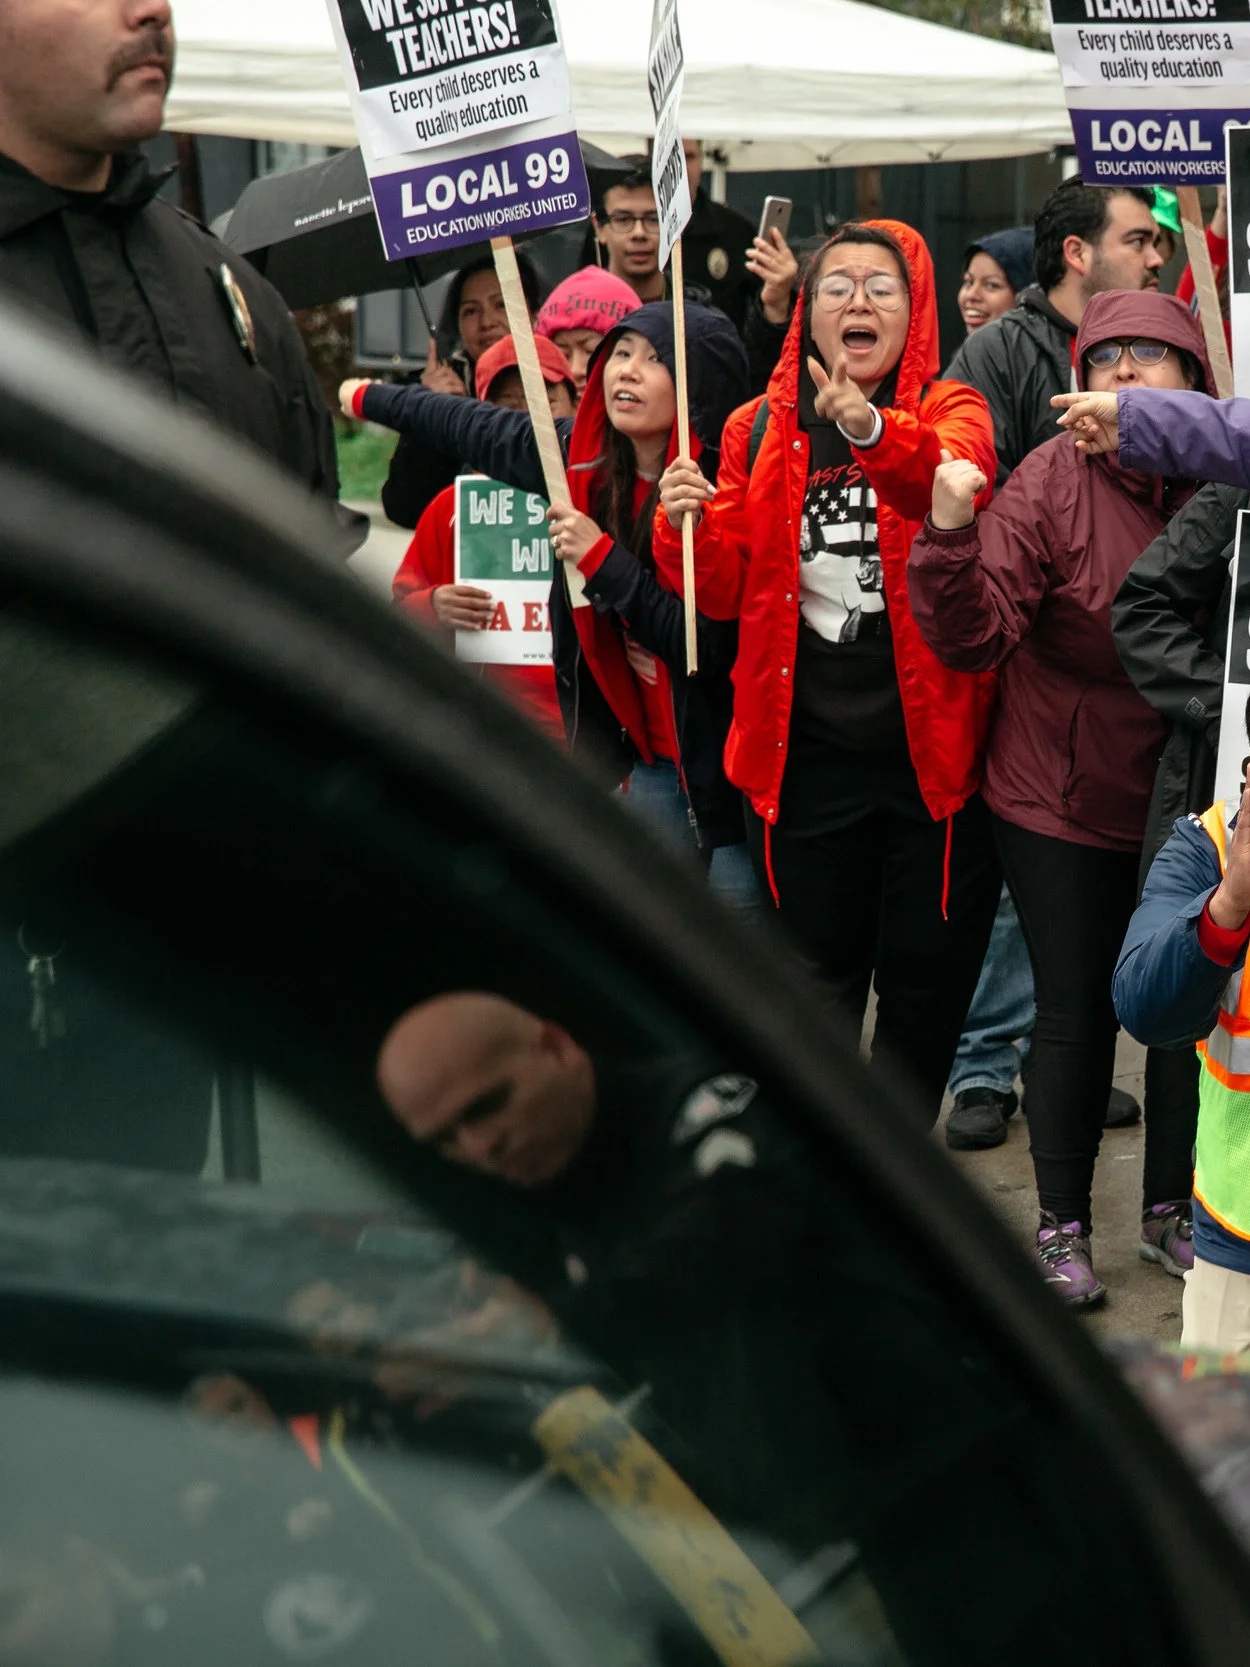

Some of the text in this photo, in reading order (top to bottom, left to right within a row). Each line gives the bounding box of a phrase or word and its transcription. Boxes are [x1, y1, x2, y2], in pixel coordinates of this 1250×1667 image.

[385, 1, 520, 75] TEACHERS!
[1078, 30, 1234, 54] Every child deserves a
[389, 60, 540, 114] Every child deserves a
[1100, 57, 1224, 81] quality education
[415, 94, 529, 142] quality education
[1090, 119, 1212, 152] LOCAL
[401, 147, 570, 219] LOCAL 99
[1095, 160, 1226, 176] EDUCATION WORKERS
[406, 192, 578, 244] EDUCATION WORKERS UNITED
[469, 489, 515, 525] WE
